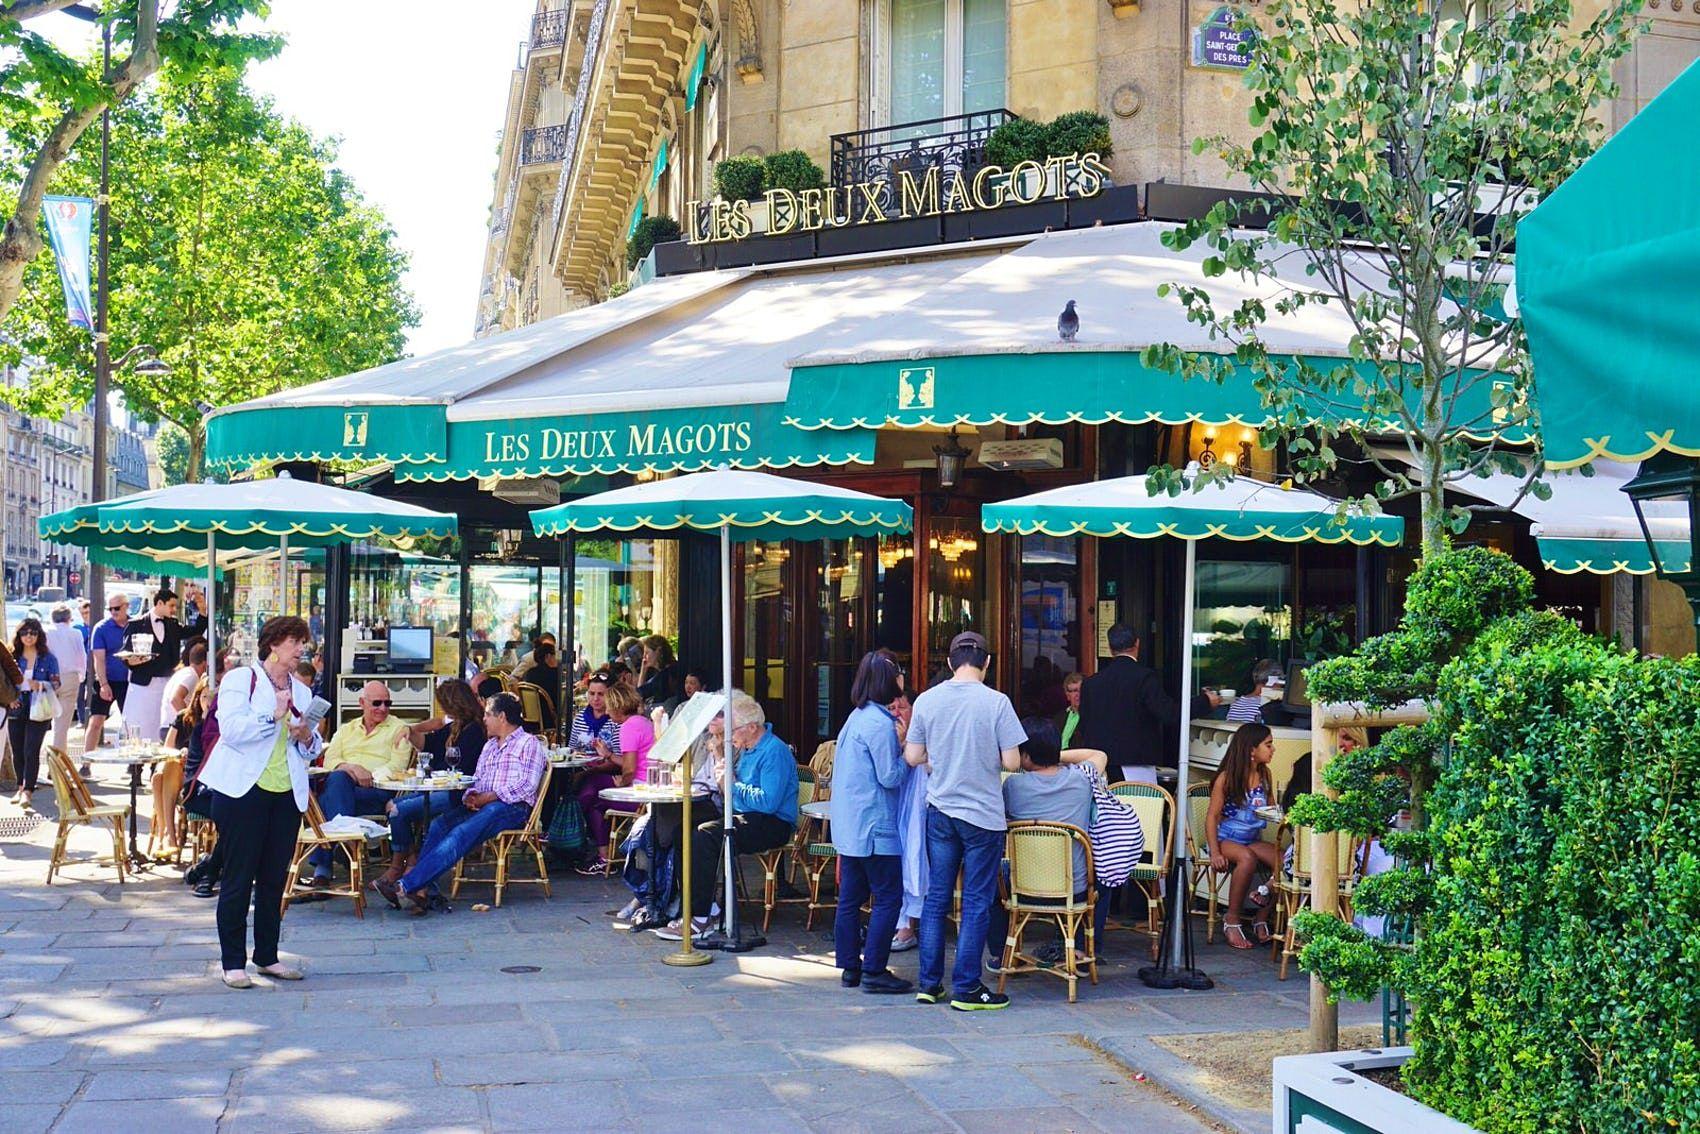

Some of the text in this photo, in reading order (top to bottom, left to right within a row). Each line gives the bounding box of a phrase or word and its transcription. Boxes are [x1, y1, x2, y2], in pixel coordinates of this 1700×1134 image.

[1220, 31, 1241, 41] PLACE
[1206, 41, 1238, 52] SAINT-GE
[1213, 52, 1227, 62] DES
[686, 151, 1101, 245] LES DEUX MAGOTS
[484, 422, 751, 463] LES DEUX MAGOTS
